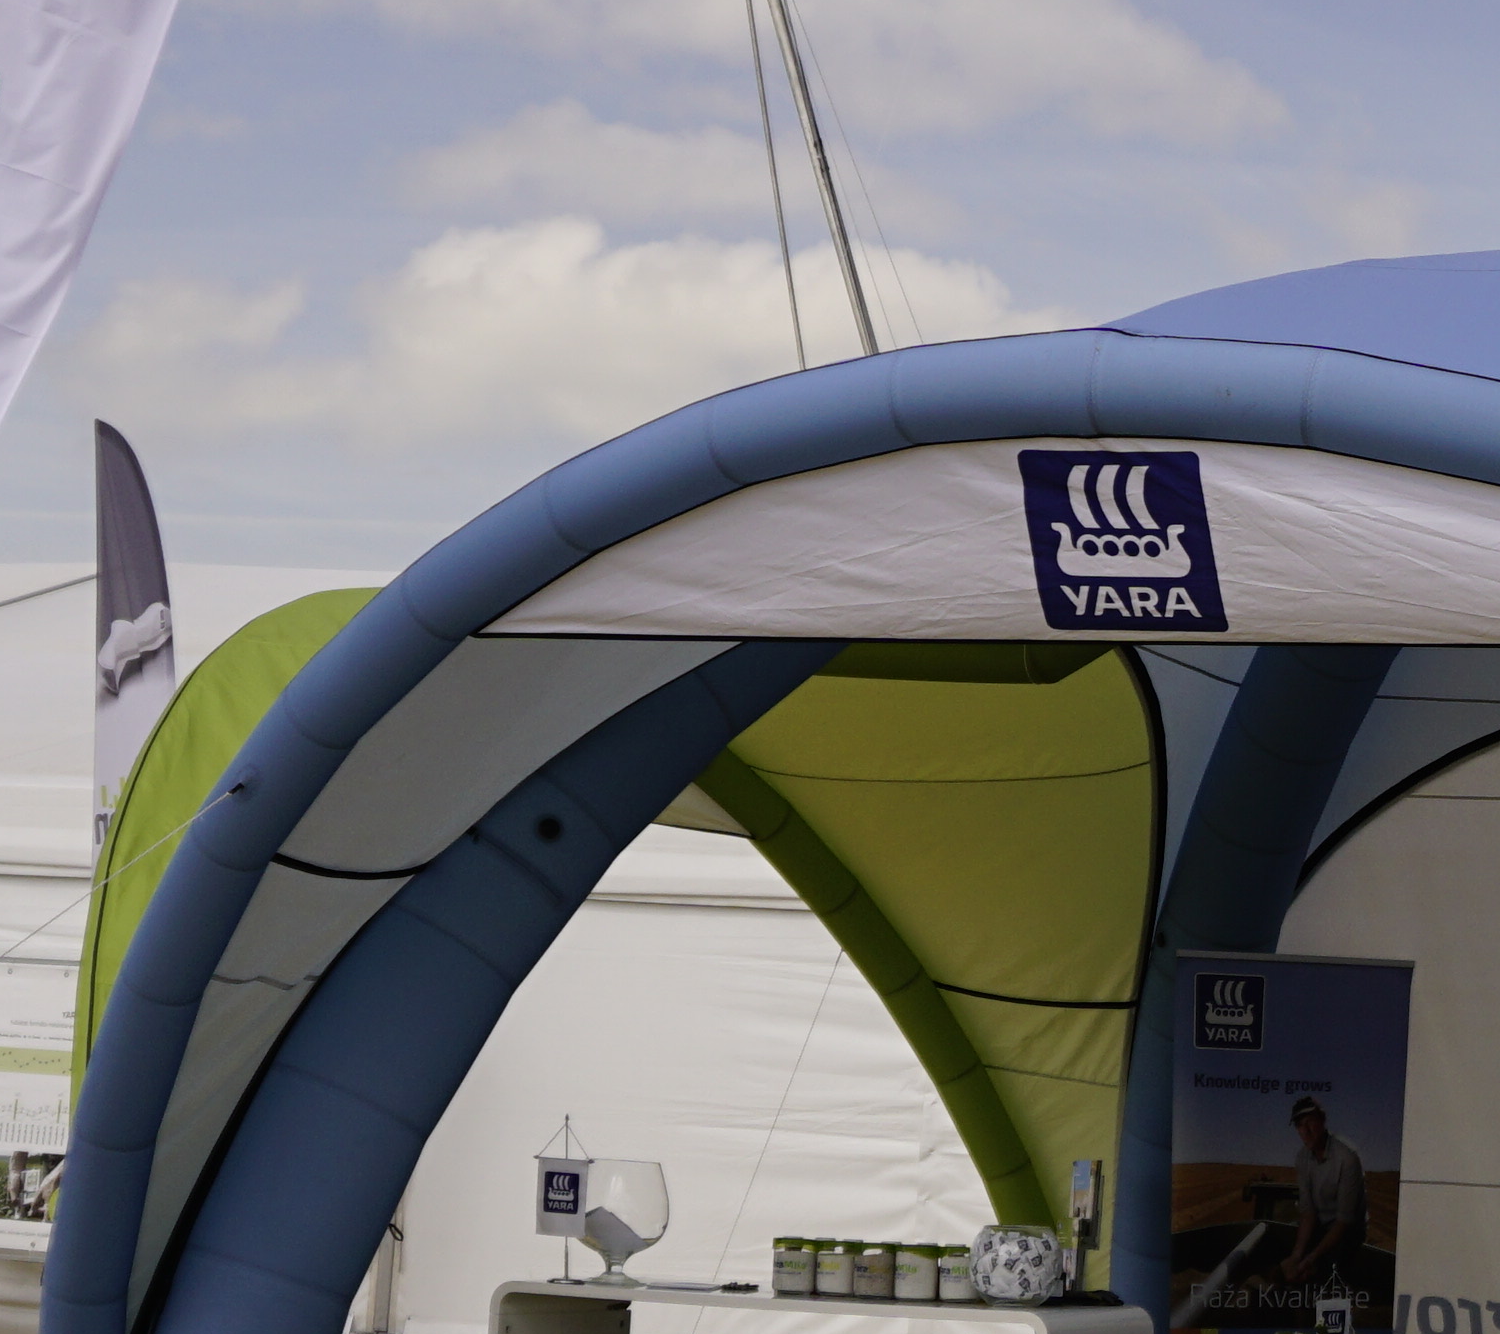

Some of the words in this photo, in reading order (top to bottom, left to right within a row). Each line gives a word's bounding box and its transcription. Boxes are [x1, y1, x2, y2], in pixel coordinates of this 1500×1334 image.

[1059, 585, 1203, 618] YARA
[1204, 1026, 1253, 1043] YARA
[1193, 1073, 1280, 1094] Knowledge
[1285, 1079, 1333, 1095] grows
[547, 1200, 574, 1211] YARA
